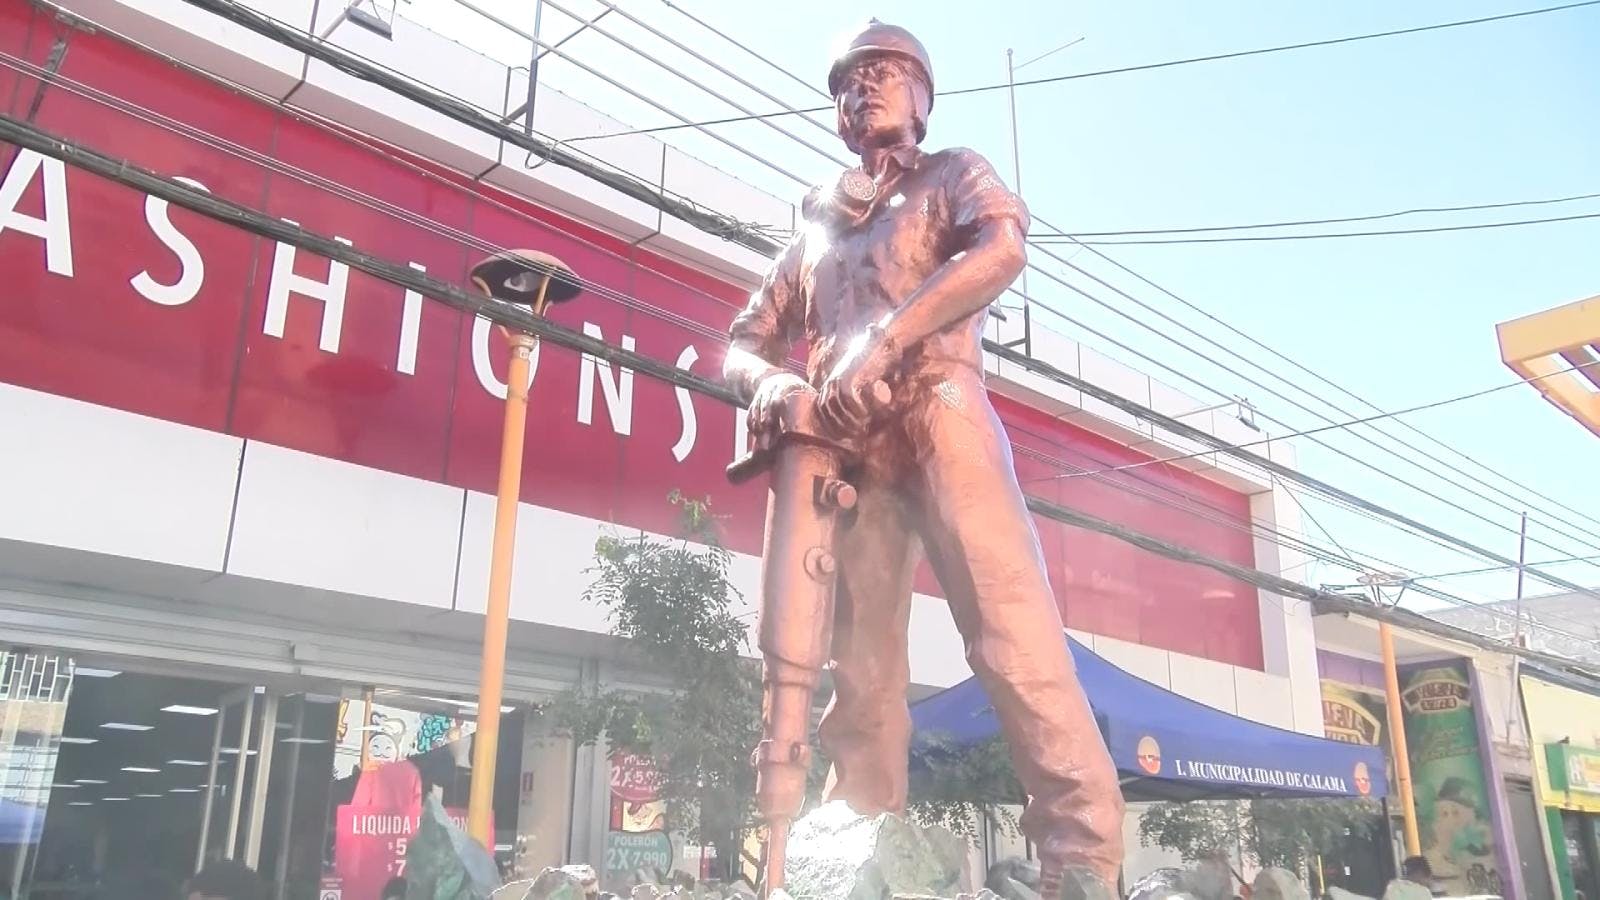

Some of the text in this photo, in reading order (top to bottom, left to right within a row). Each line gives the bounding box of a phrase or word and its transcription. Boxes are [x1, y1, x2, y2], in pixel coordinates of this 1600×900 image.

[0, 147, 749, 463] ASHIONS
[1188, 761, 1285, 785] MUNICIPALIDAD
[1286, 771, 1302, 788] DE
[1303, 774, 1348, 792] CALAMA
[352, 815, 412, 835] LIQUIDA
